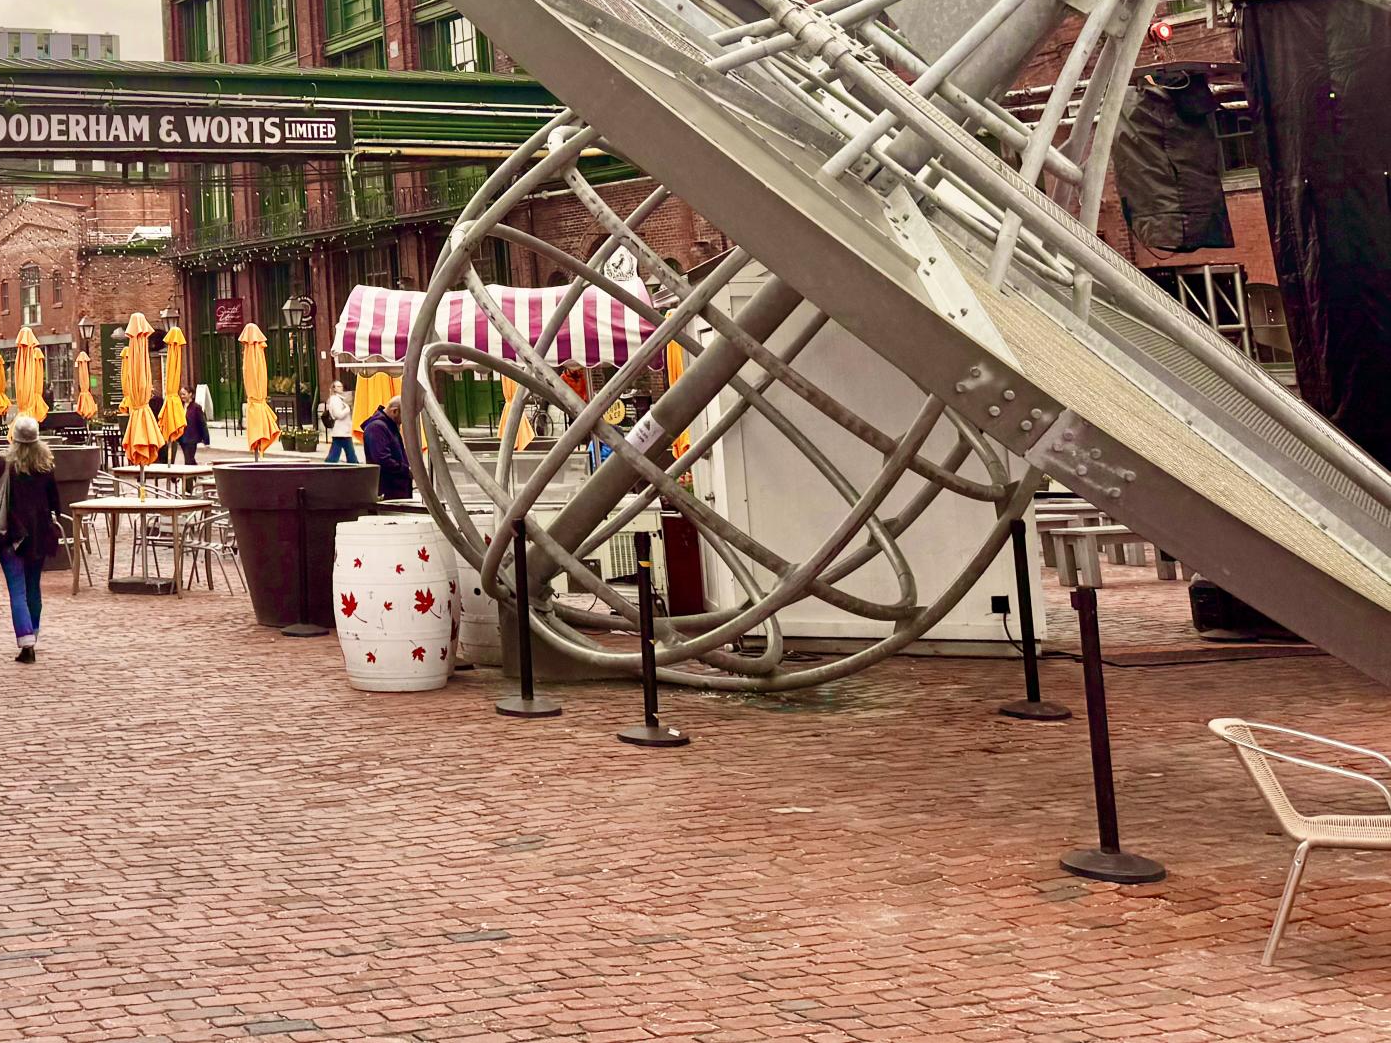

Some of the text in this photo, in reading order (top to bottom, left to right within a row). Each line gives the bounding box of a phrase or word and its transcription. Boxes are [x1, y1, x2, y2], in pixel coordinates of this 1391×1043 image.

[159, 115, 182, 144] &
[185, 115, 282, 145] WORTS
[284, 122, 336, 139] LIMITED
